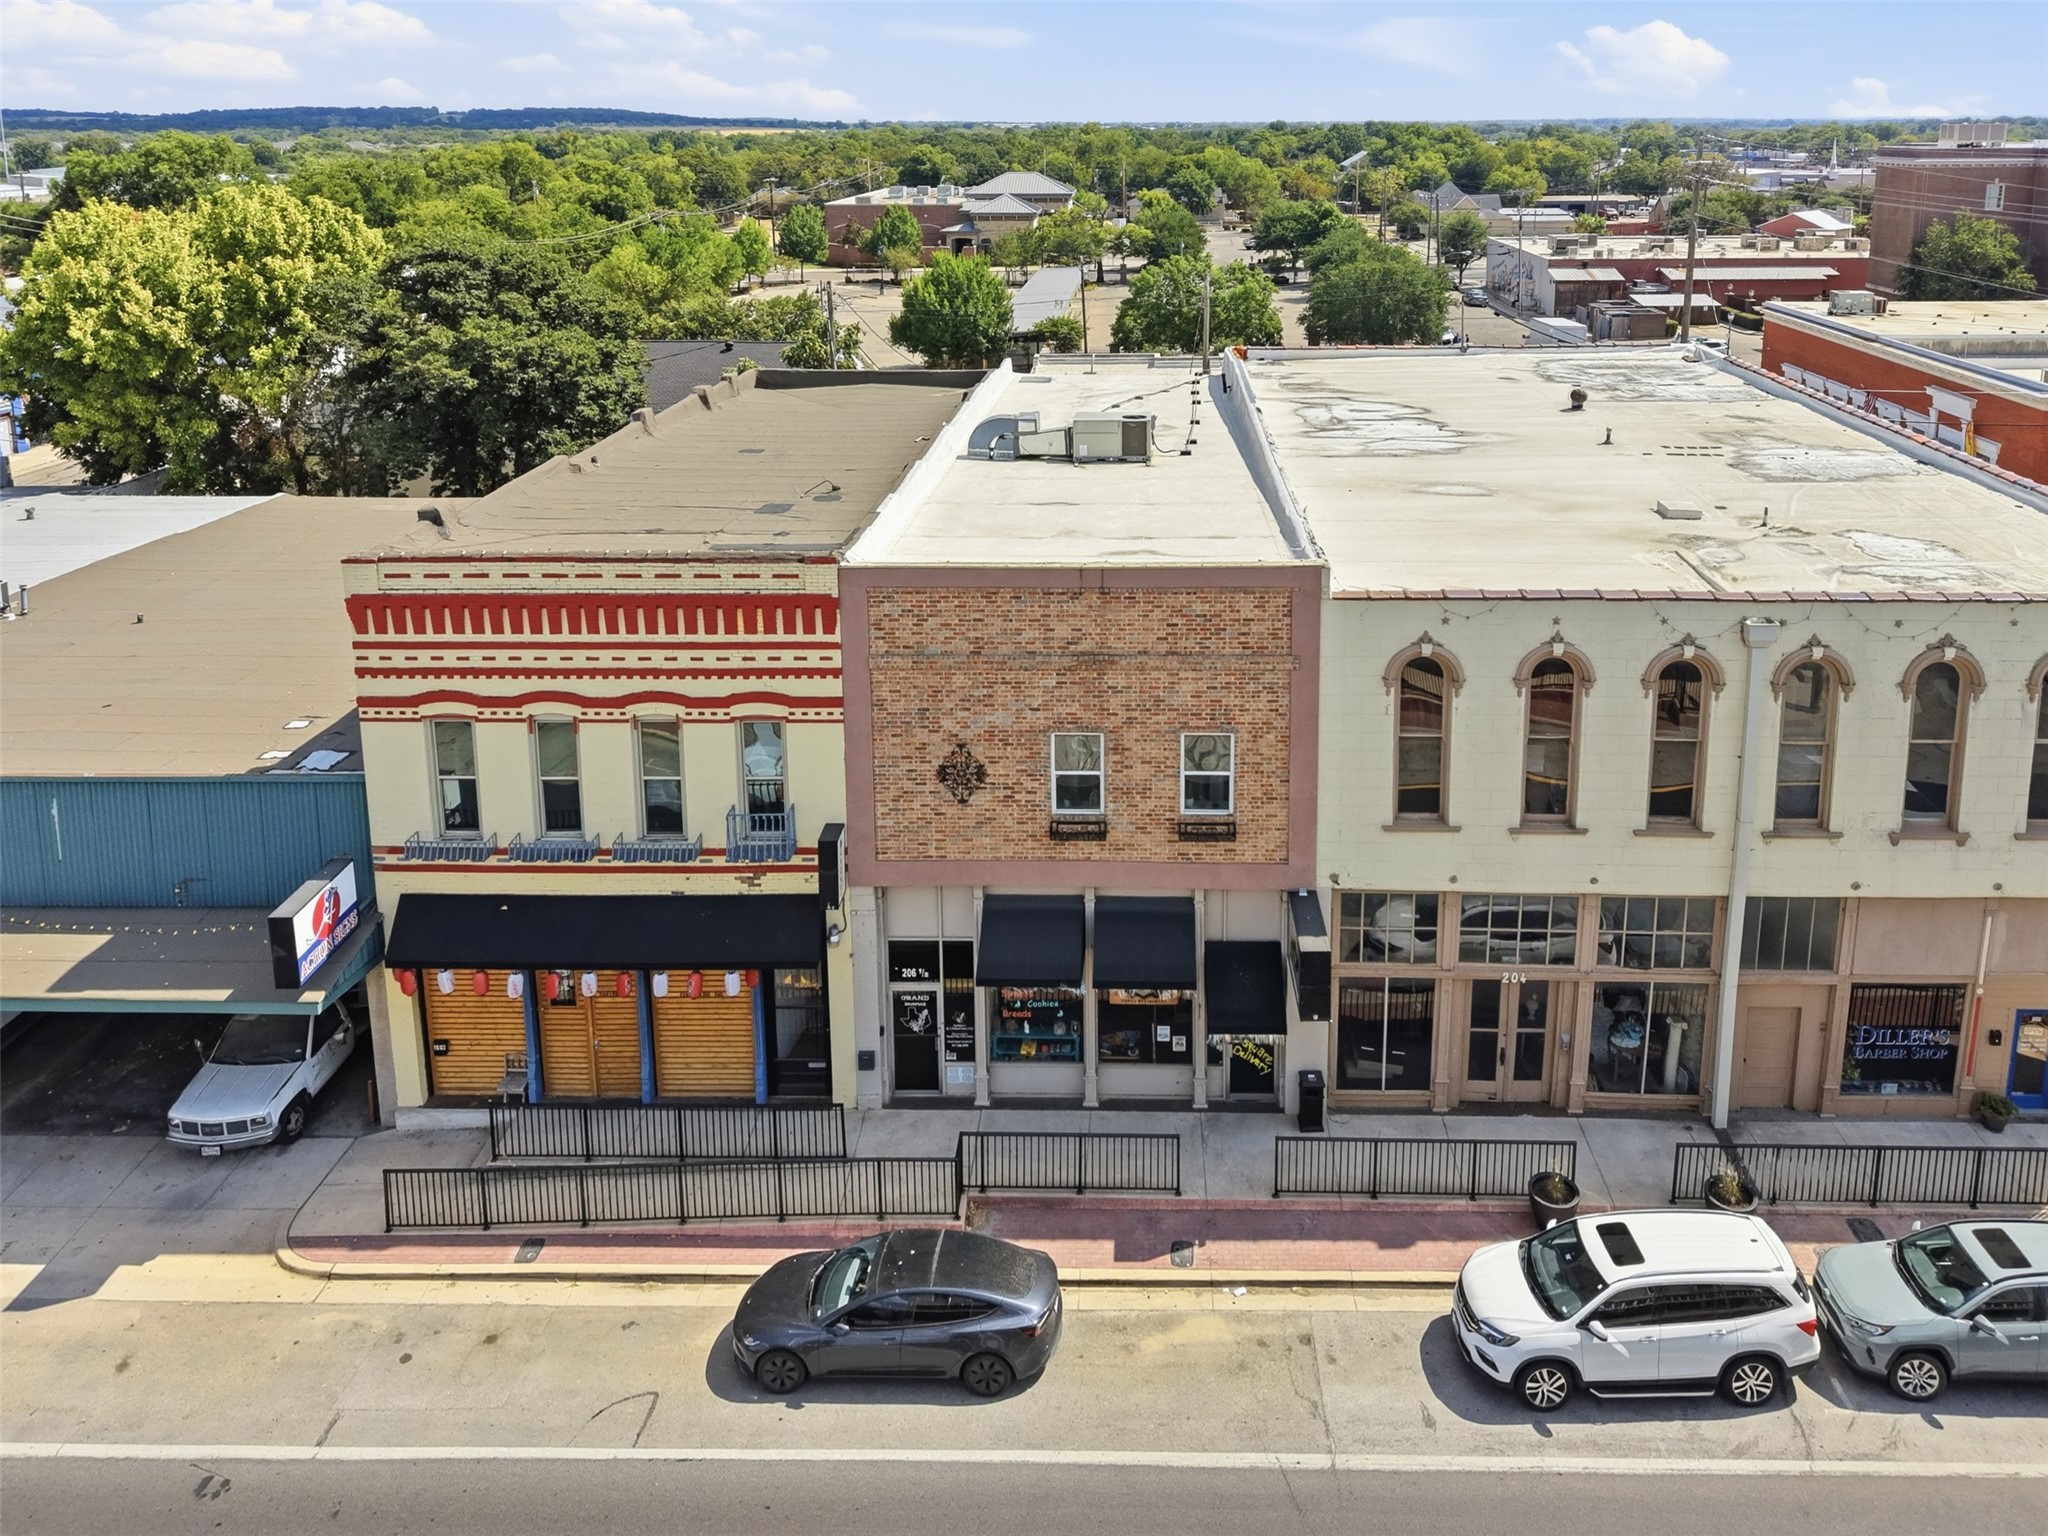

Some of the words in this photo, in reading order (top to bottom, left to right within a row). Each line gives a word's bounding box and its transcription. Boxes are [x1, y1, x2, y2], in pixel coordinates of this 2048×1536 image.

[300, 935, 334, 982] ACTION
[333, 909, 359, 946] SIGNS
[901, 968, 917, 978] 206
[1502, 972, 1527, 984] 204
[1027, 999, 1060, 1008] Cookies
[1855, 1025, 1951, 1046] DILLER'S
[1855, 1046, 1908, 1060] BARBER
[1910, 1046, 1949, 1060] SHOP
[1233, 1045, 1273, 1076] Delivery
